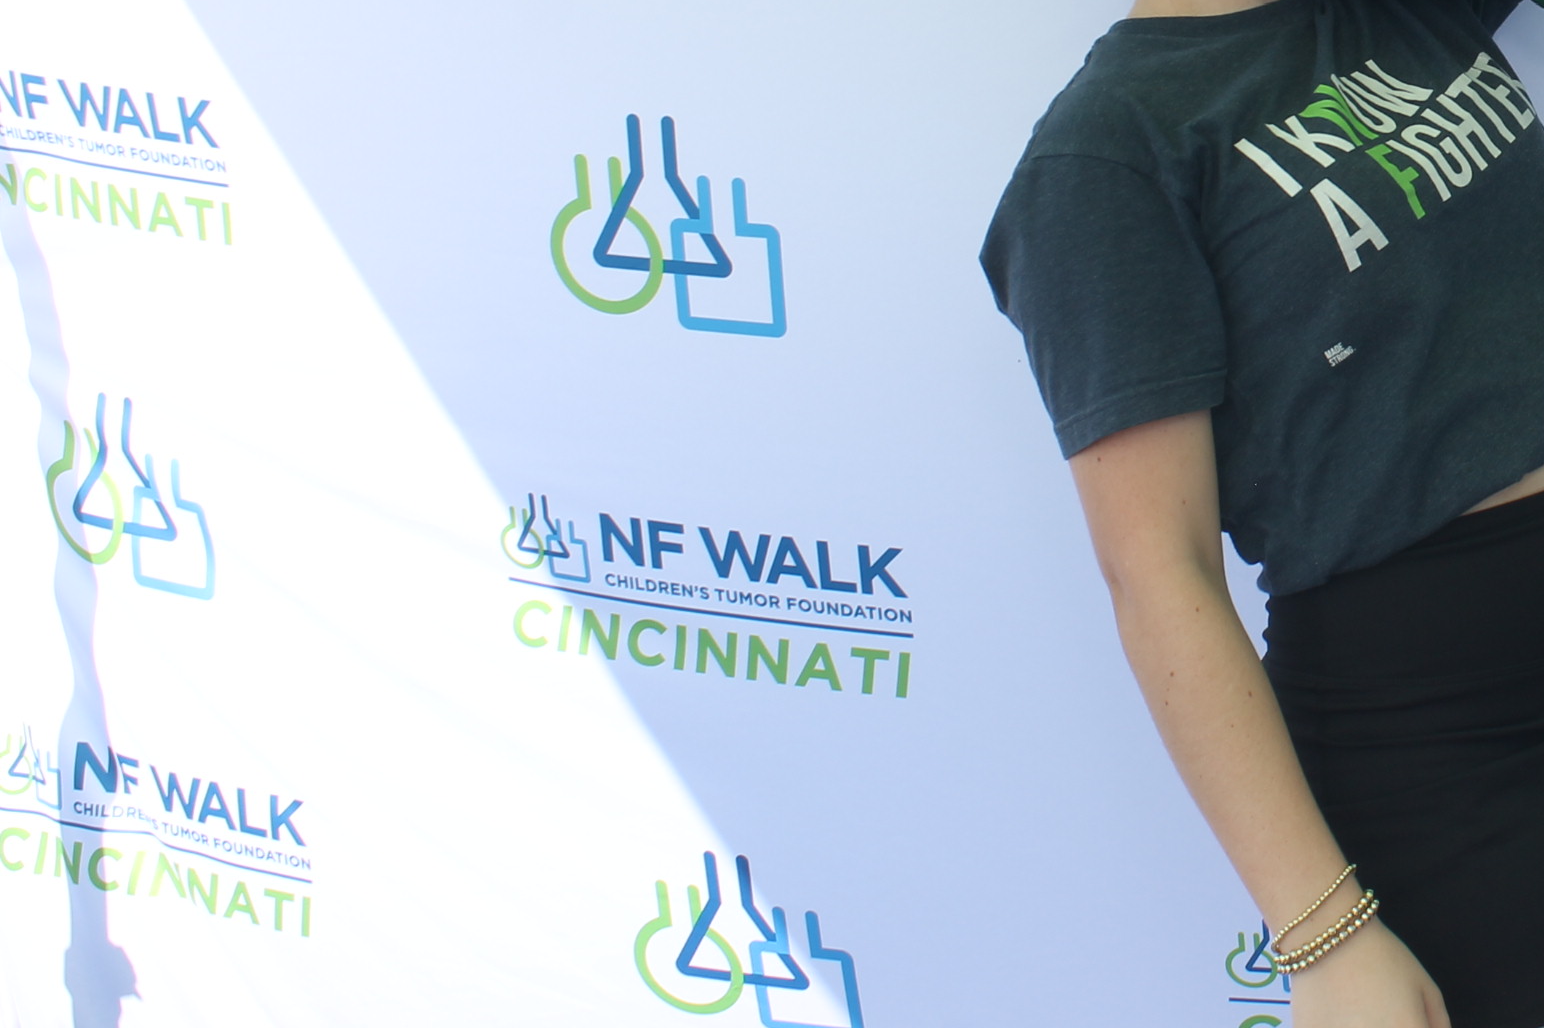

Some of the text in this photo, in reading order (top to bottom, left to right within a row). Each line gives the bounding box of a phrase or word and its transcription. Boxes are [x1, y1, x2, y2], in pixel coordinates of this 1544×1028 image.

[57, 78, 220, 149] WALK
[78, 138, 125, 157] TUMOR
[131, 147, 227, 173] FOUNDATION
[1234, 59, 1434, 198] I KNOW
[1310, 178, 1389, 272] A
[599, 512, 909, 599] NF WALK
[604, 572, 914, 624] CHILDREN'S TUMOR FOUNDATION
[513, 599, 912, 700] CINCINNATI
[73, 741, 306, 847] NF WALK
[0, 826, 311, 937] CINCINNATI
[161, 821, 210, 846] TUMOR
[213, 837, 312, 870] FOUNDATION
